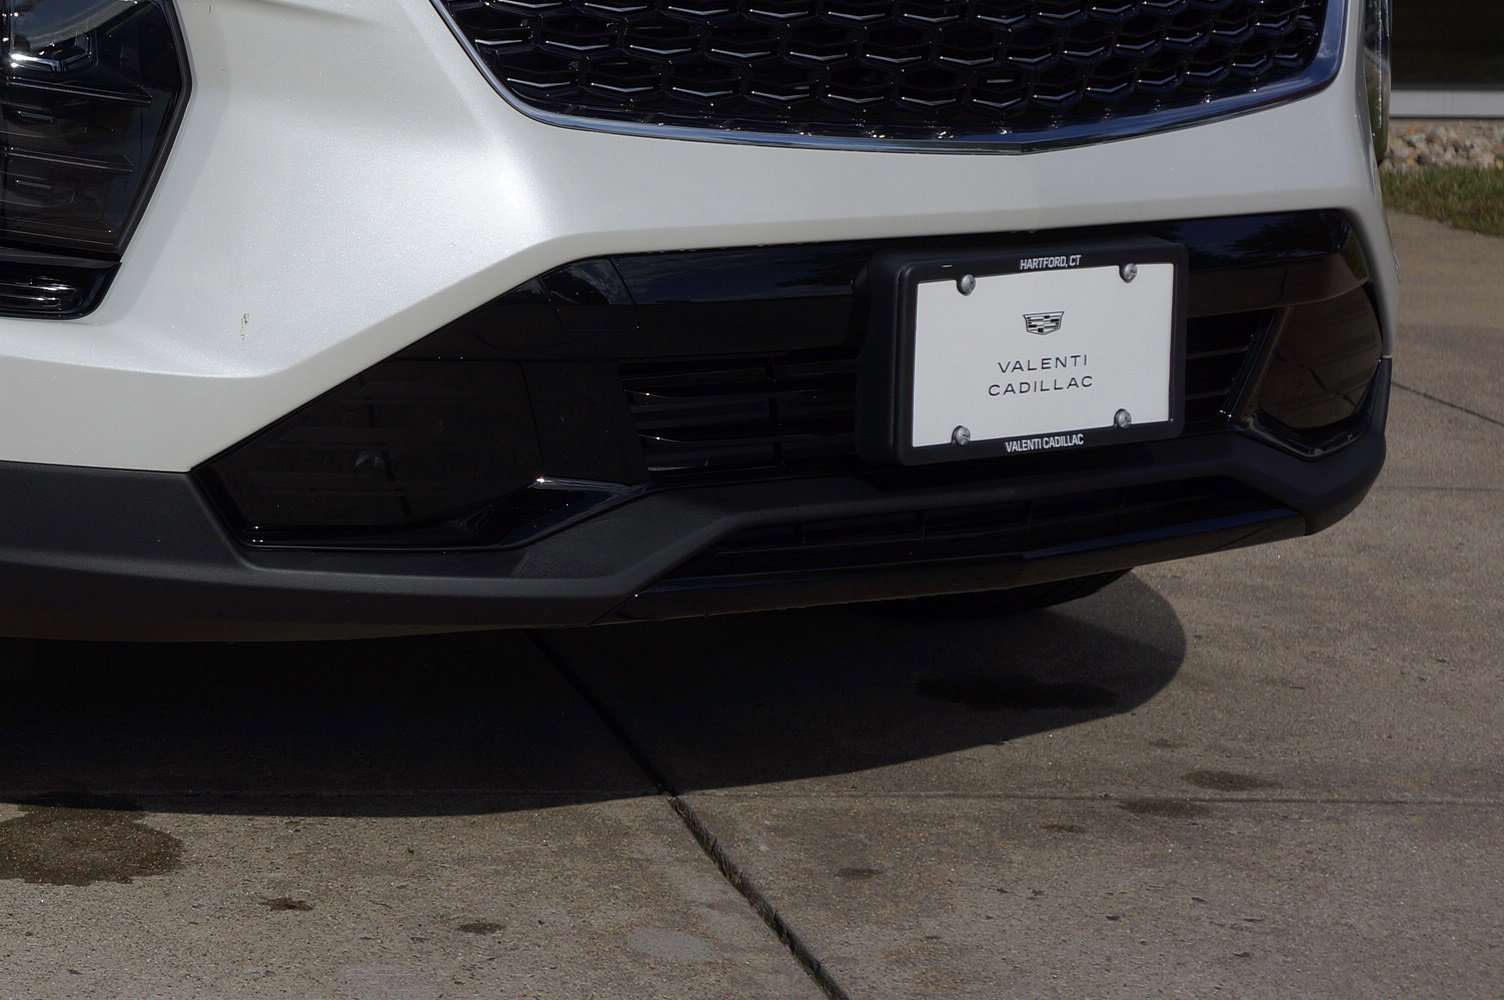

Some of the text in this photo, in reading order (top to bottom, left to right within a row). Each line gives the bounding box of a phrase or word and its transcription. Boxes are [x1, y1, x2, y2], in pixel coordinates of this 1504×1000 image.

[1020, 254, 1082, 271] HARTFORD, CT
[997, 353, 1089, 374] VALENTI
[987, 374, 1094, 397] CADILLAC
[1005, 433, 1084, 453] VALENTI CADILLAC
